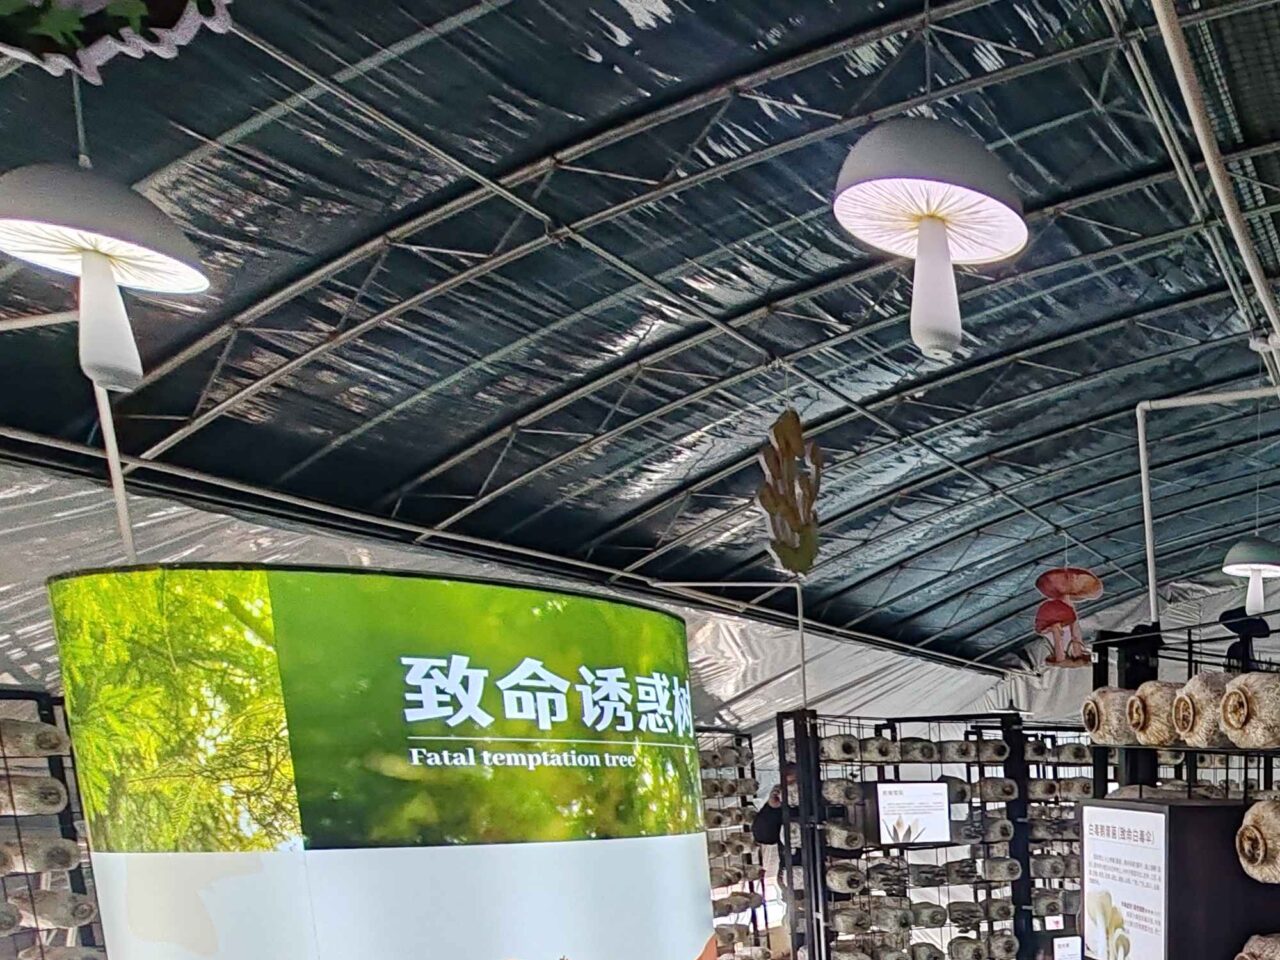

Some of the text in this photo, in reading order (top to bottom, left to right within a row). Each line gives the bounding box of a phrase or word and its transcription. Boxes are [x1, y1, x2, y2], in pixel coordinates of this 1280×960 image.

[400, 654, 694, 738] 致命诱惑树
[408, 748, 636, 771] Fatal temptation tree
